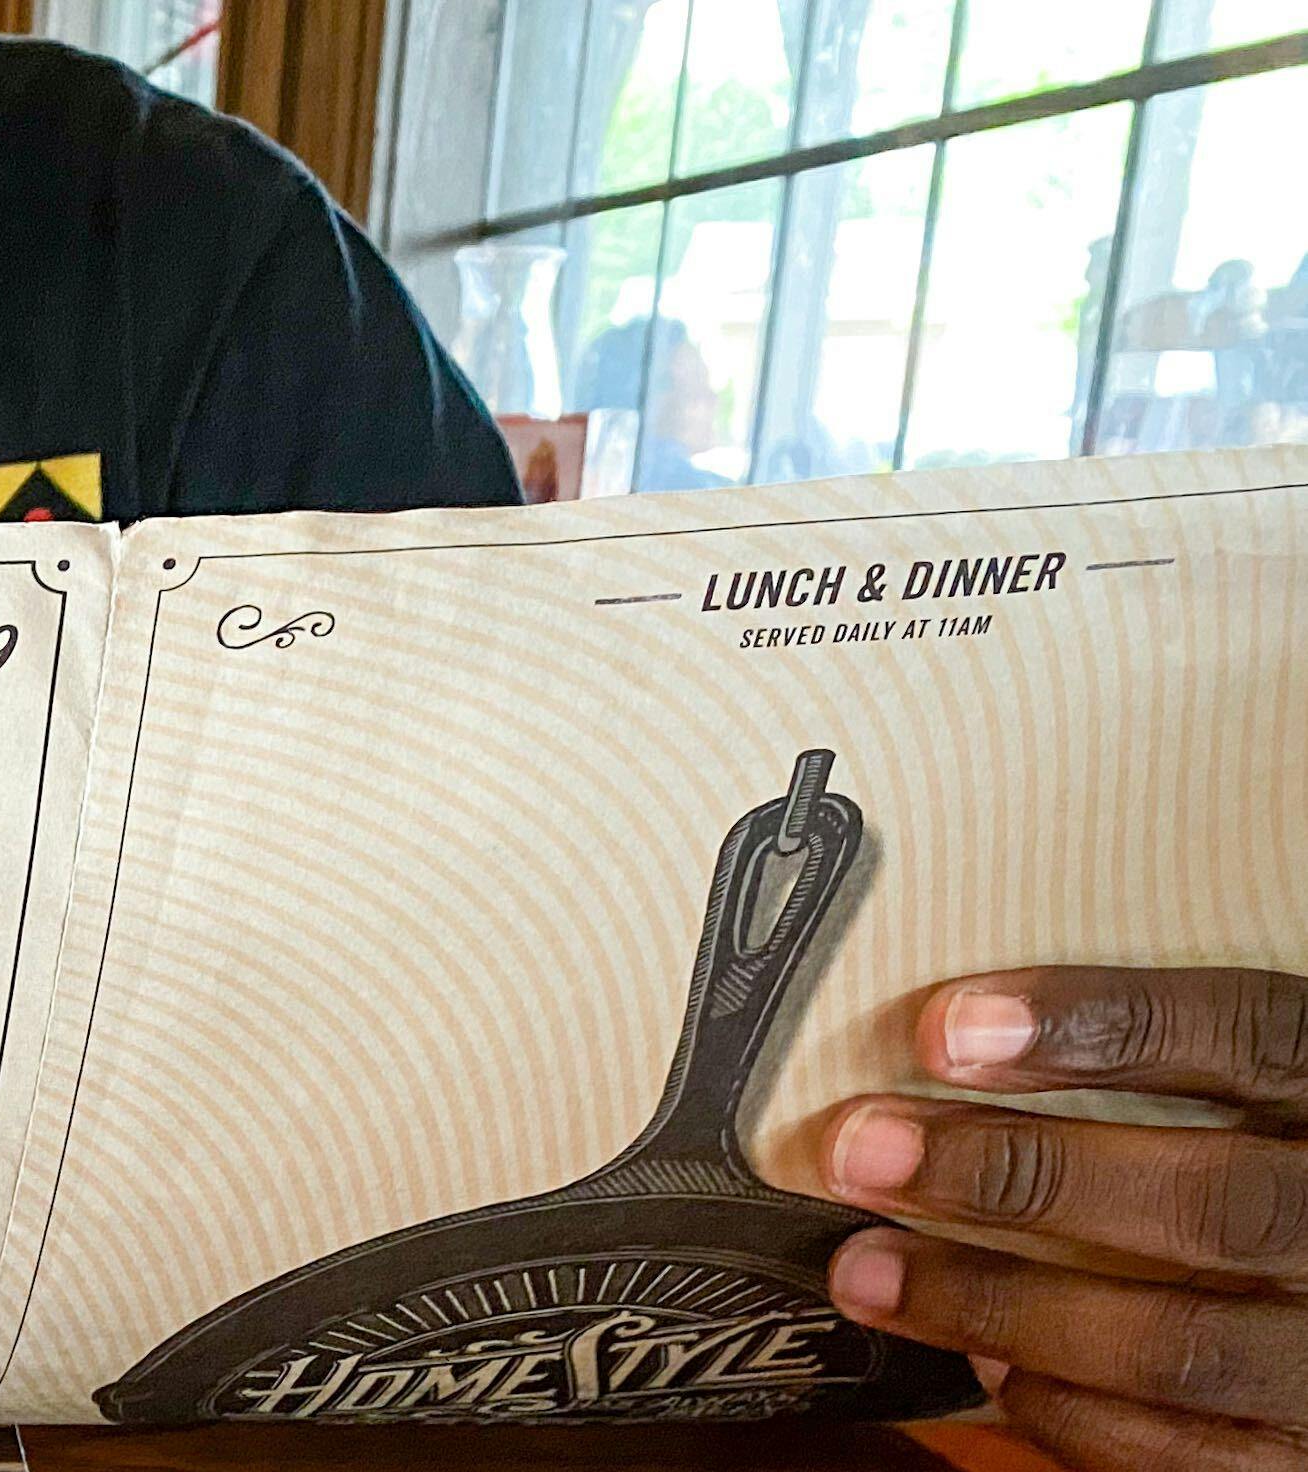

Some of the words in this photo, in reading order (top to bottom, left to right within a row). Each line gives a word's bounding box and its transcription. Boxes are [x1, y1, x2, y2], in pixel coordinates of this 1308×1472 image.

[701, 566, 846, 612] LUNCH
[857, 564, 888, 601] &
[903, 552, 1067, 601] DINNER
[739, 624, 827, 649] SERVED
[834, 621, 896, 645] DAILY
[901, 619, 931, 641] AT
[937, 614, 993, 638] 11AM
